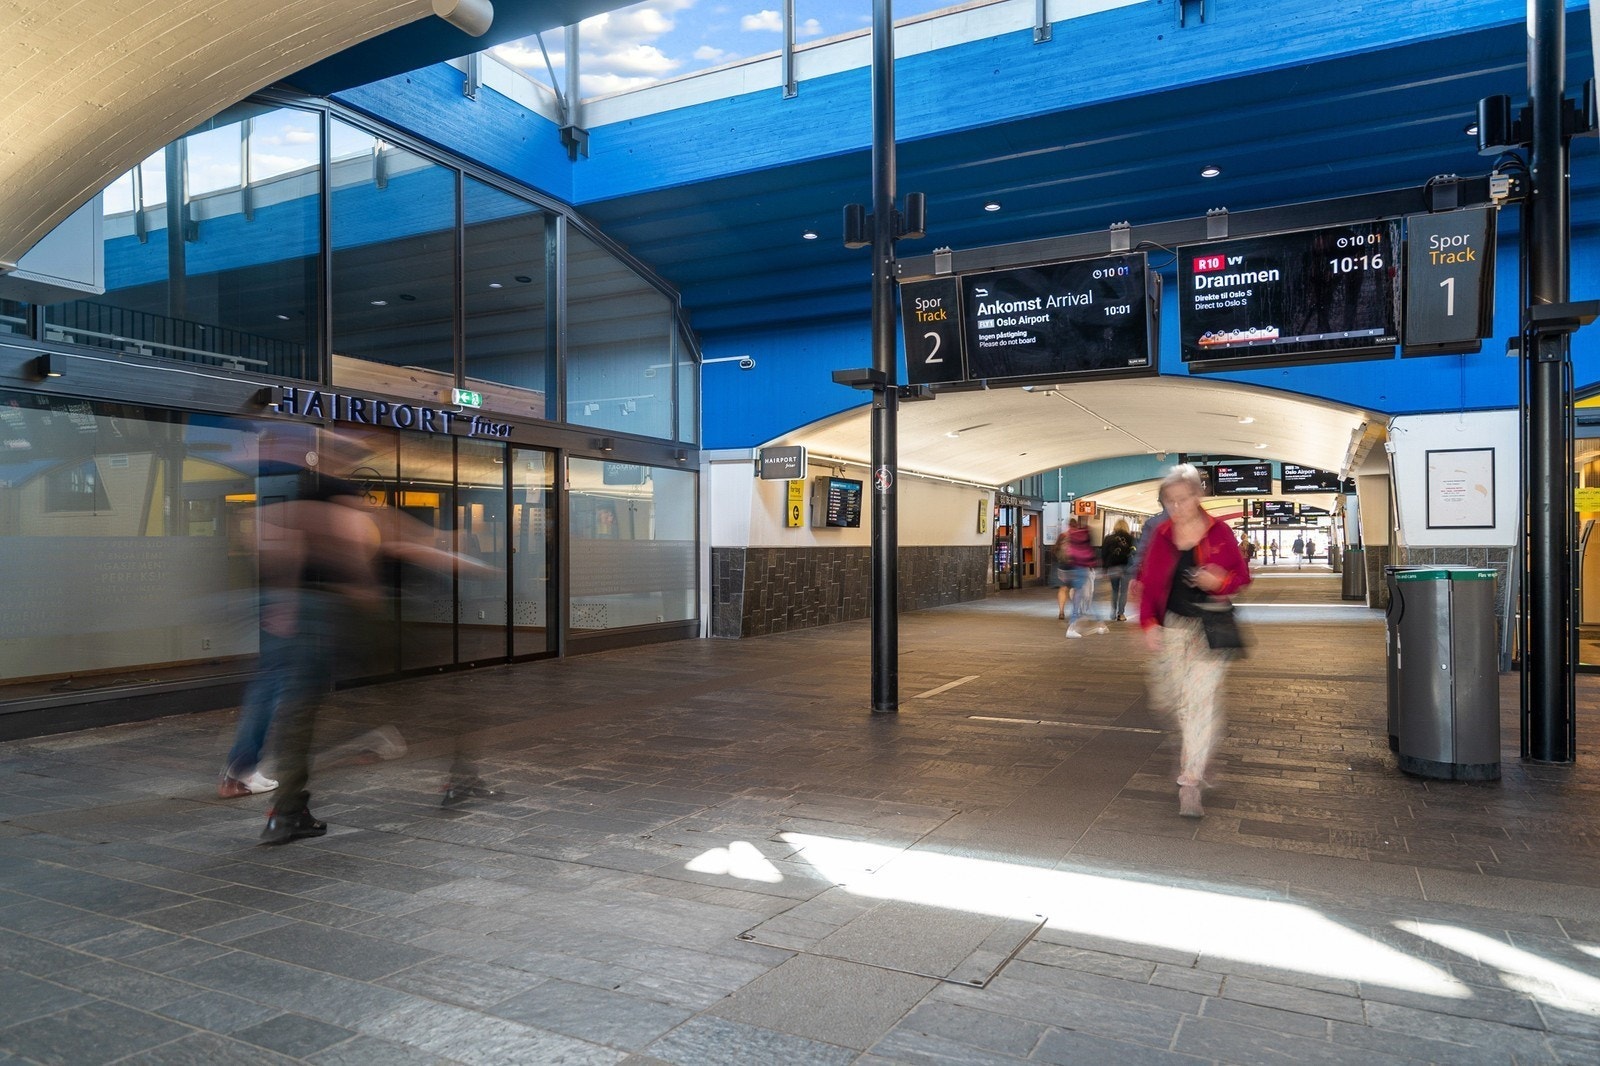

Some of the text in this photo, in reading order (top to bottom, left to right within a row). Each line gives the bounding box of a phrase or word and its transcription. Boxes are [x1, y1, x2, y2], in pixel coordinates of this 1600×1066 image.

[1429, 232, 1470, 251] Spor
[1198, 257, 1220, 270] R10
[1329, 253, 1384, 274] 10:16
[1429, 247, 1476, 266] Track
[1194, 268, 1280, 290] Drammen
[915, 296, 942, 311] Spor
[977, 289, 1093, 316] Ankomst Arrival
[1194, 289, 1252, 303] Direkte til Oslo S
[1439, 277, 1455, 316] 1
[1104, 304, 1131, 316] 10:01
[1195, 298, 1247, 311] Direct to Oslo S
[916, 308, 947, 323] Track
[996, 317, 1017, 327] Oslo
[1018, 313, 1050, 326] Airport
[978, 330, 1028, 342] Ingen påstigning
[979, 340, 999, 348] Please
[1018, 336, 1036, 345] board
[923, 331, 944, 364] 2
[275, 385, 515, 438] HAIRPORT frisør
[764, 456, 797, 464] HAIRPORT
